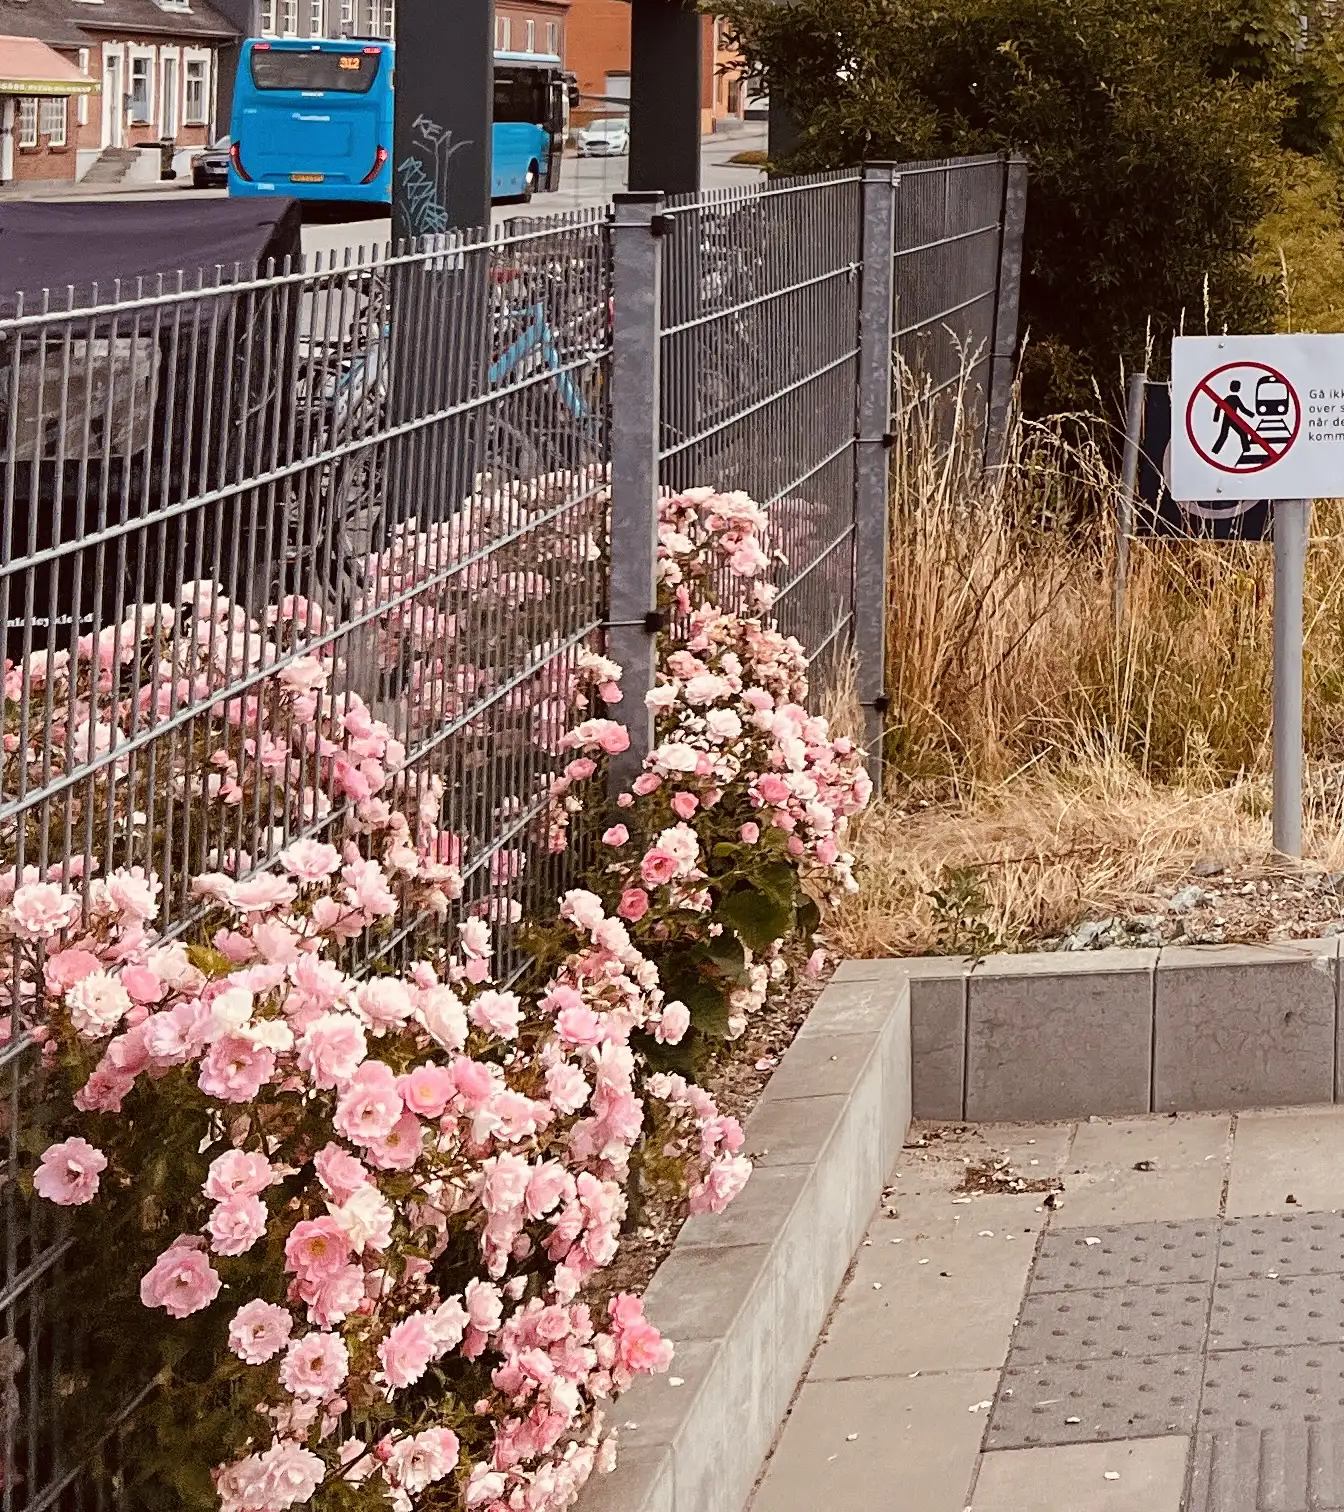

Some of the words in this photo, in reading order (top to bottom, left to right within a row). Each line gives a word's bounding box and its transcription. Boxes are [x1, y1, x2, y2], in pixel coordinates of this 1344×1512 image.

[1309, 389, 1325, 399] Gå
[1309, 404, 1336, 413] over
[1308, 417, 1329, 427] når
